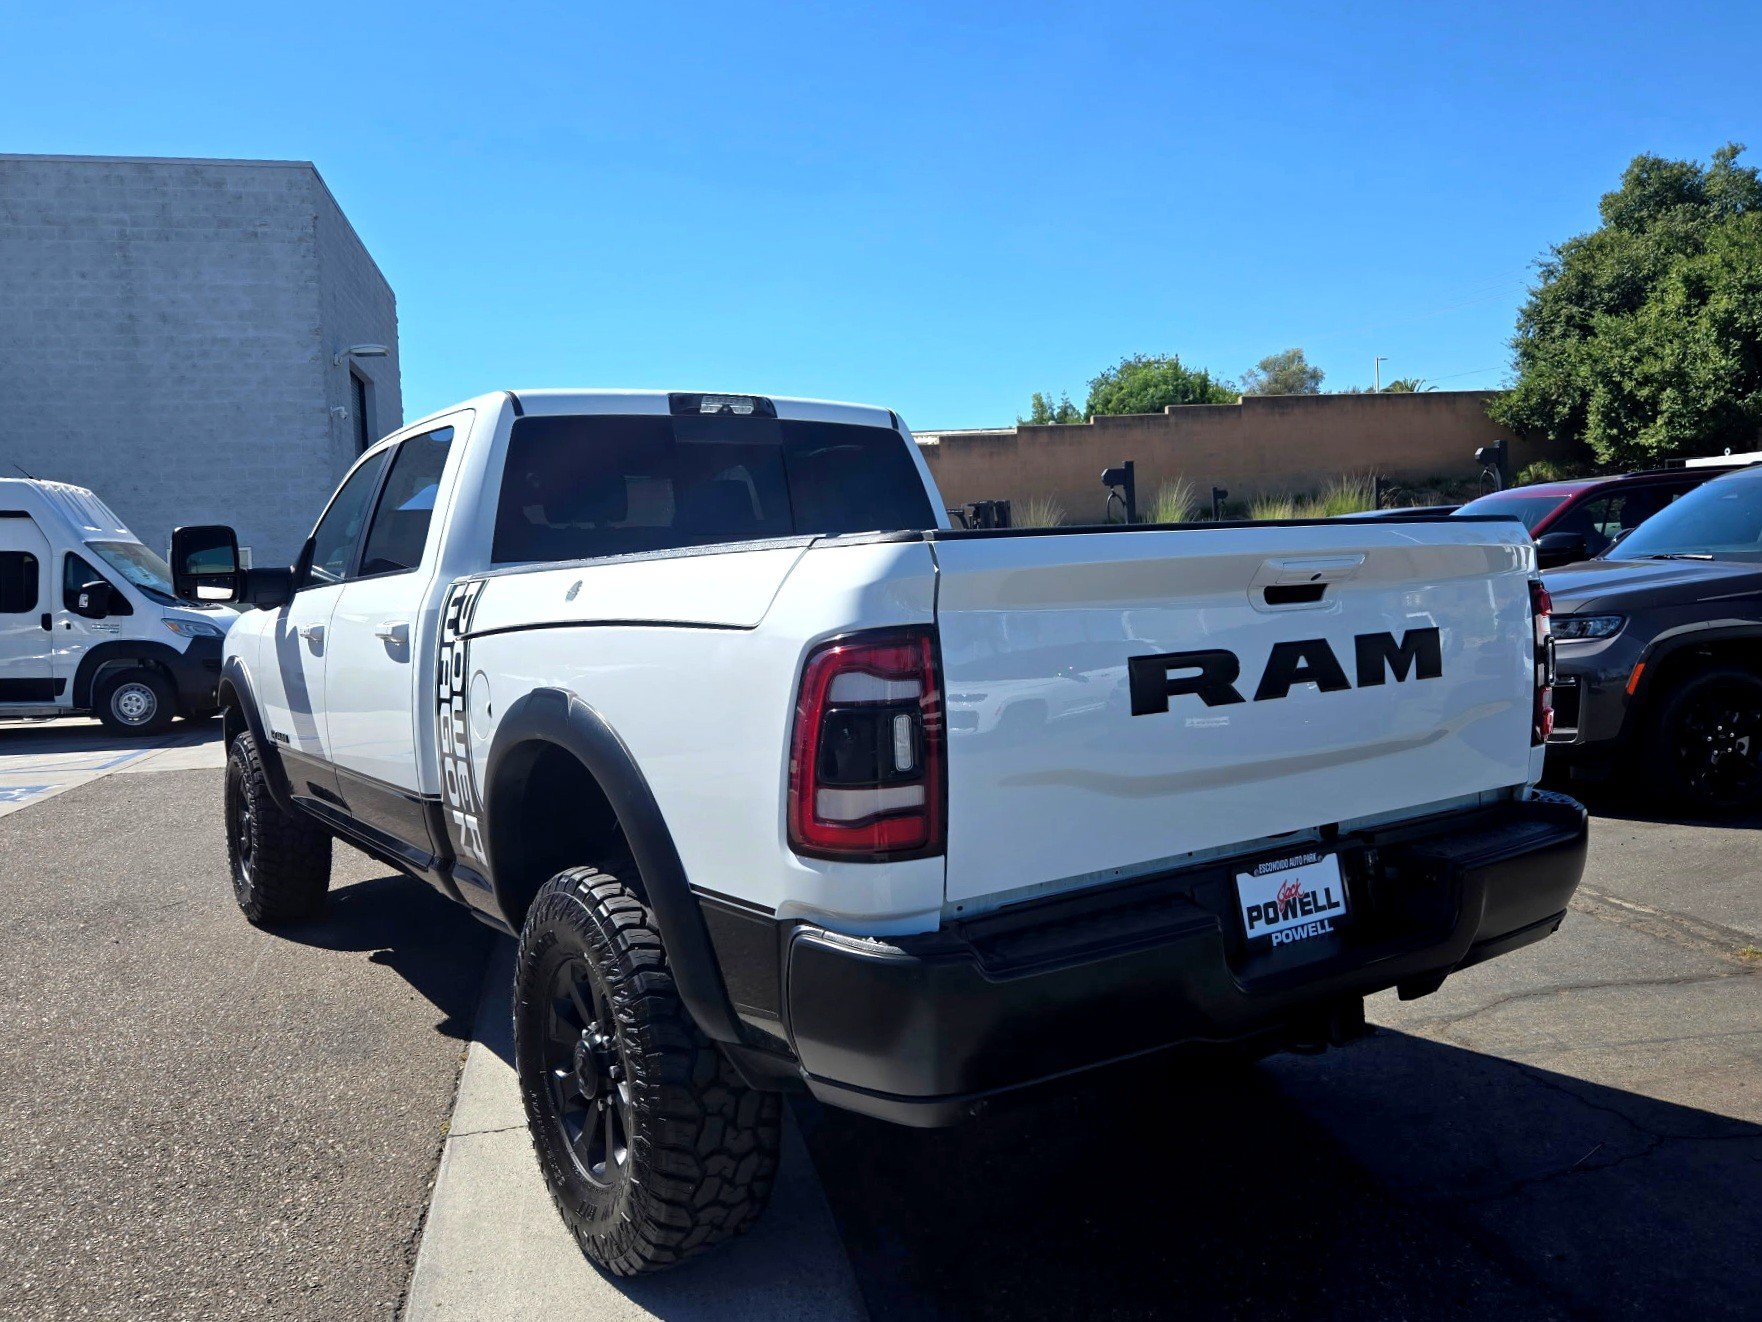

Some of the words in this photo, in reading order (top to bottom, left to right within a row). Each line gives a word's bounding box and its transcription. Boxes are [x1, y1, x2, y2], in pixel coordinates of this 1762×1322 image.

[1128, 627, 1442, 716] RAM
[1258, 858, 1289, 875] ESCONDIDO
[1289, 855, 1303, 869] AUTO
[1303, 852, 1318, 866] PARK
[1247, 887, 1340, 930] POWELL
[1277, 878, 1304, 913] Jack
[1271, 919, 1334, 947] POWELL
